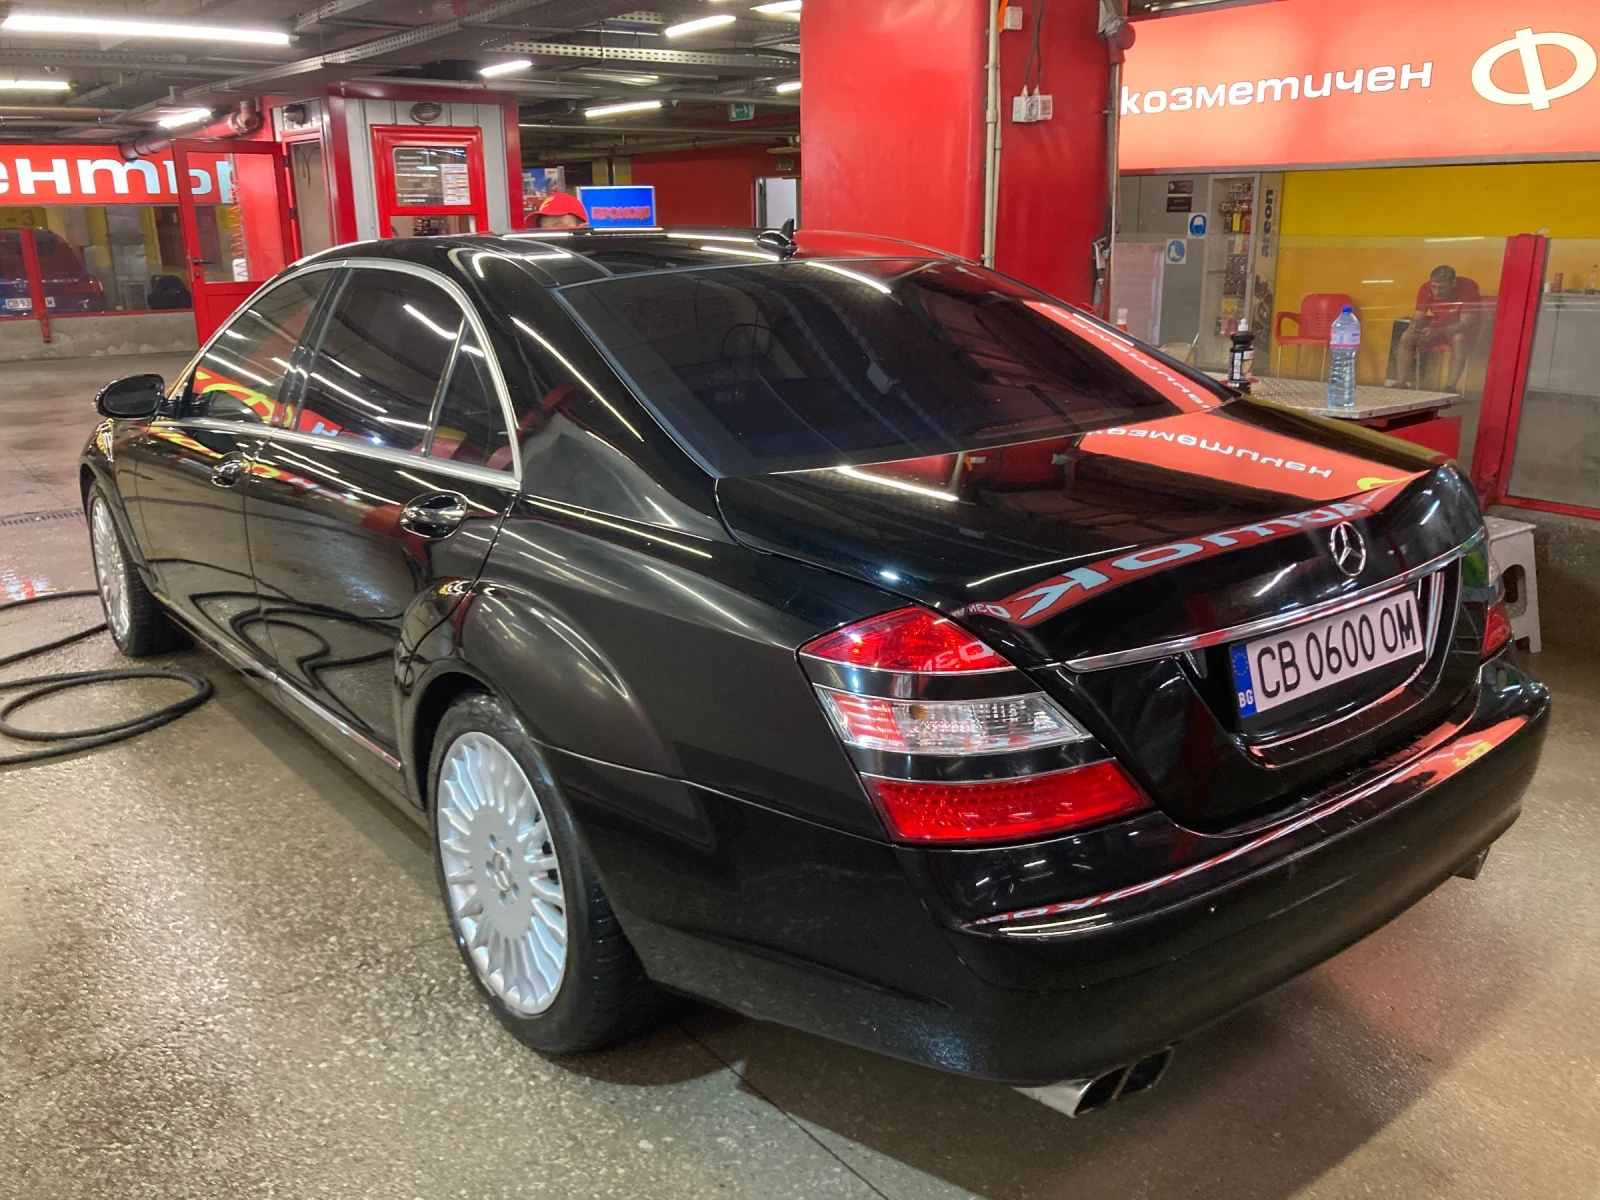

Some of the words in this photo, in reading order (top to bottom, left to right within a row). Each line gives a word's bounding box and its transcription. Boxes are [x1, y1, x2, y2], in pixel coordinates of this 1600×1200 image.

[1121, 60, 1434, 116] козметичен
[1257, 640, 1300, 699] CB
[1306, 614, 1376, 681] 0600
[1380, 598, 1417, 653] OM
[1237, 689, 1254, 709] BG
